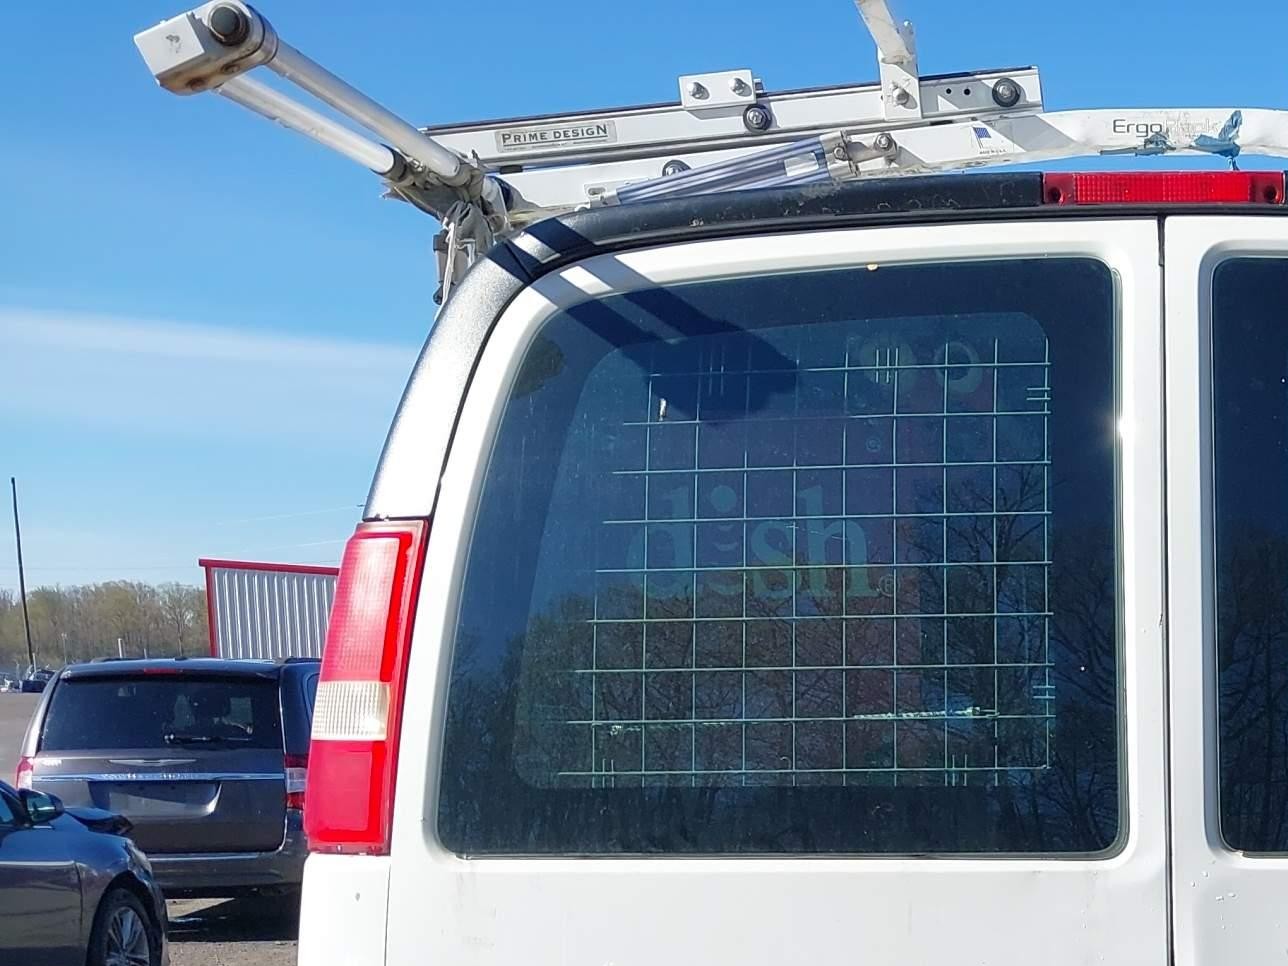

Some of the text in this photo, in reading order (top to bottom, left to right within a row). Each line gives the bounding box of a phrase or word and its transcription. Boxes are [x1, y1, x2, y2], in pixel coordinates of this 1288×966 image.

[502, 124, 608, 144] PRIME DESIGN
[626, 484, 880, 599] dish
